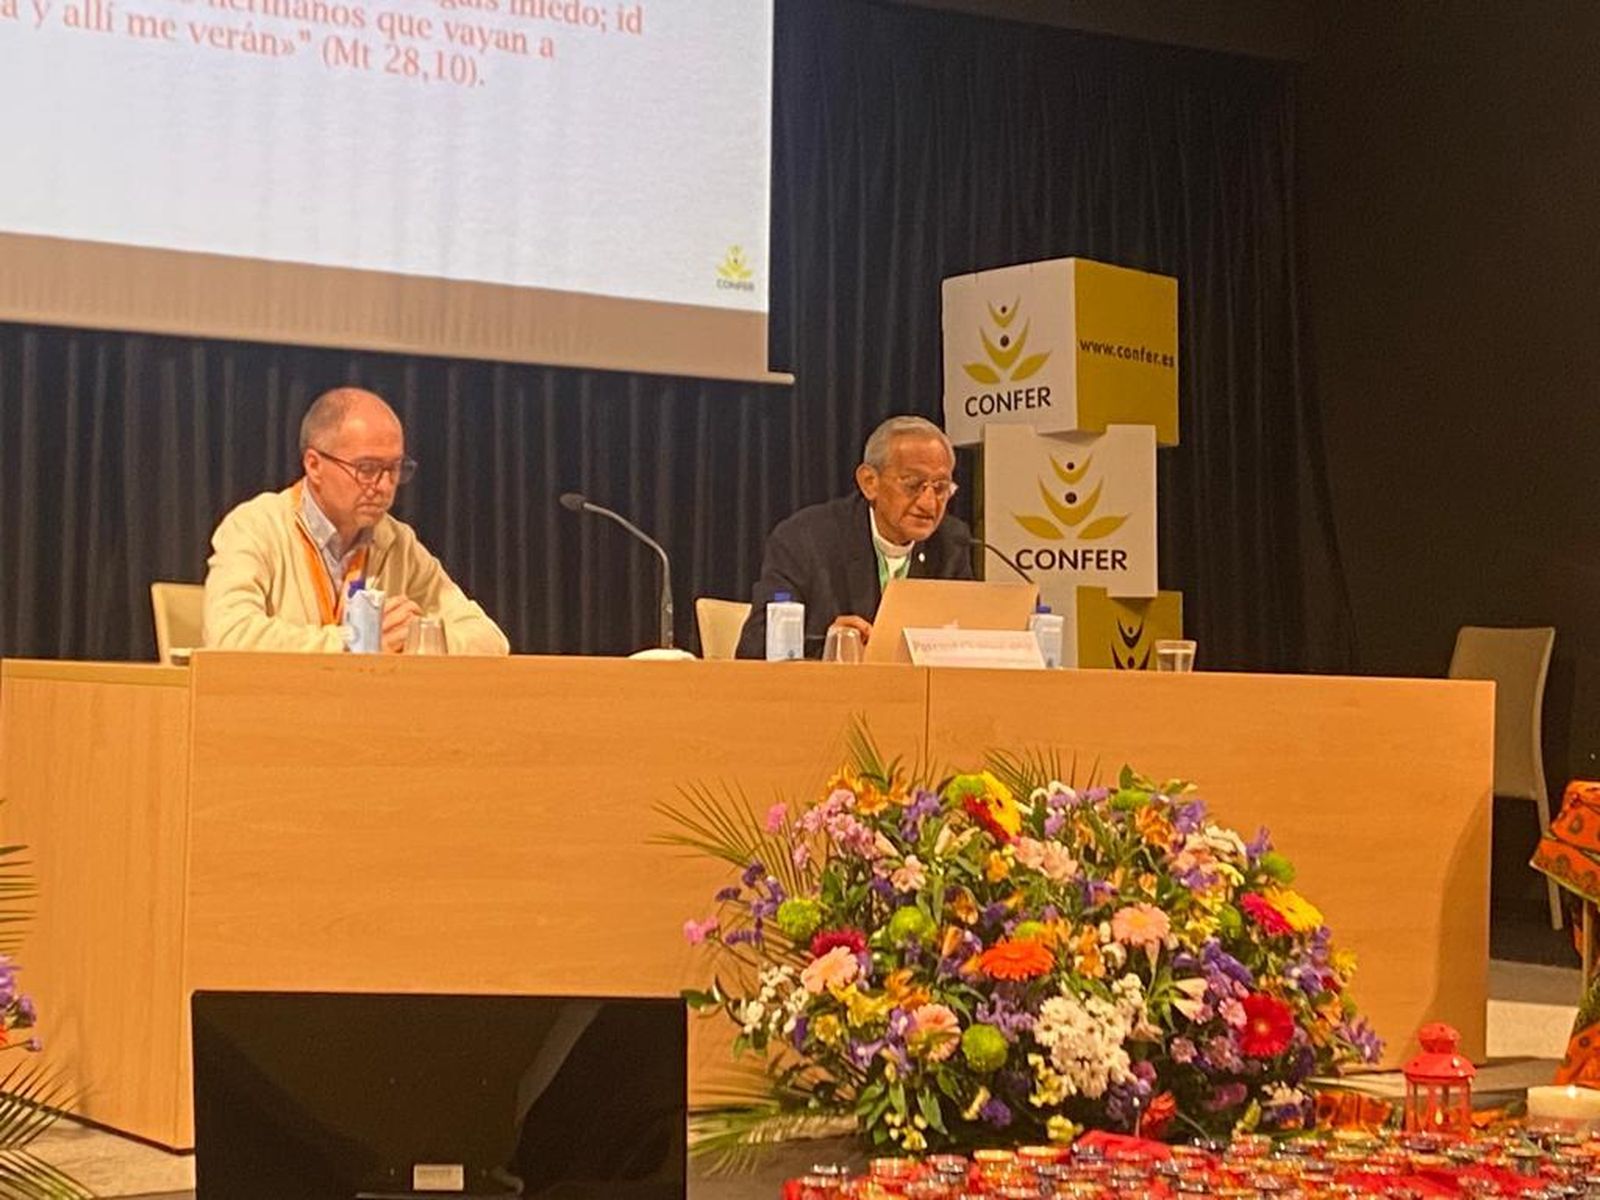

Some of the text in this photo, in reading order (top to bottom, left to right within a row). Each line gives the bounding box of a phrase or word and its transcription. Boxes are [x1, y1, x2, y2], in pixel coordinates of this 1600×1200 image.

[509, 0, 643, 34] miedo; id
[32, 0, 51, 29] y
[128, 12, 176, 40] me
[323, 34, 369, 69] (Mt
[385, 43, 485, 88] 28,10).
[377, 11, 432, 41] que
[443, 20, 527, 54] vayan
[540, 37, 554, 57] a
[1079, 339, 1175, 367] www.confer.es
[965, 386, 1051, 417] CONFER
[1015, 548, 1128, 571] CONFER
